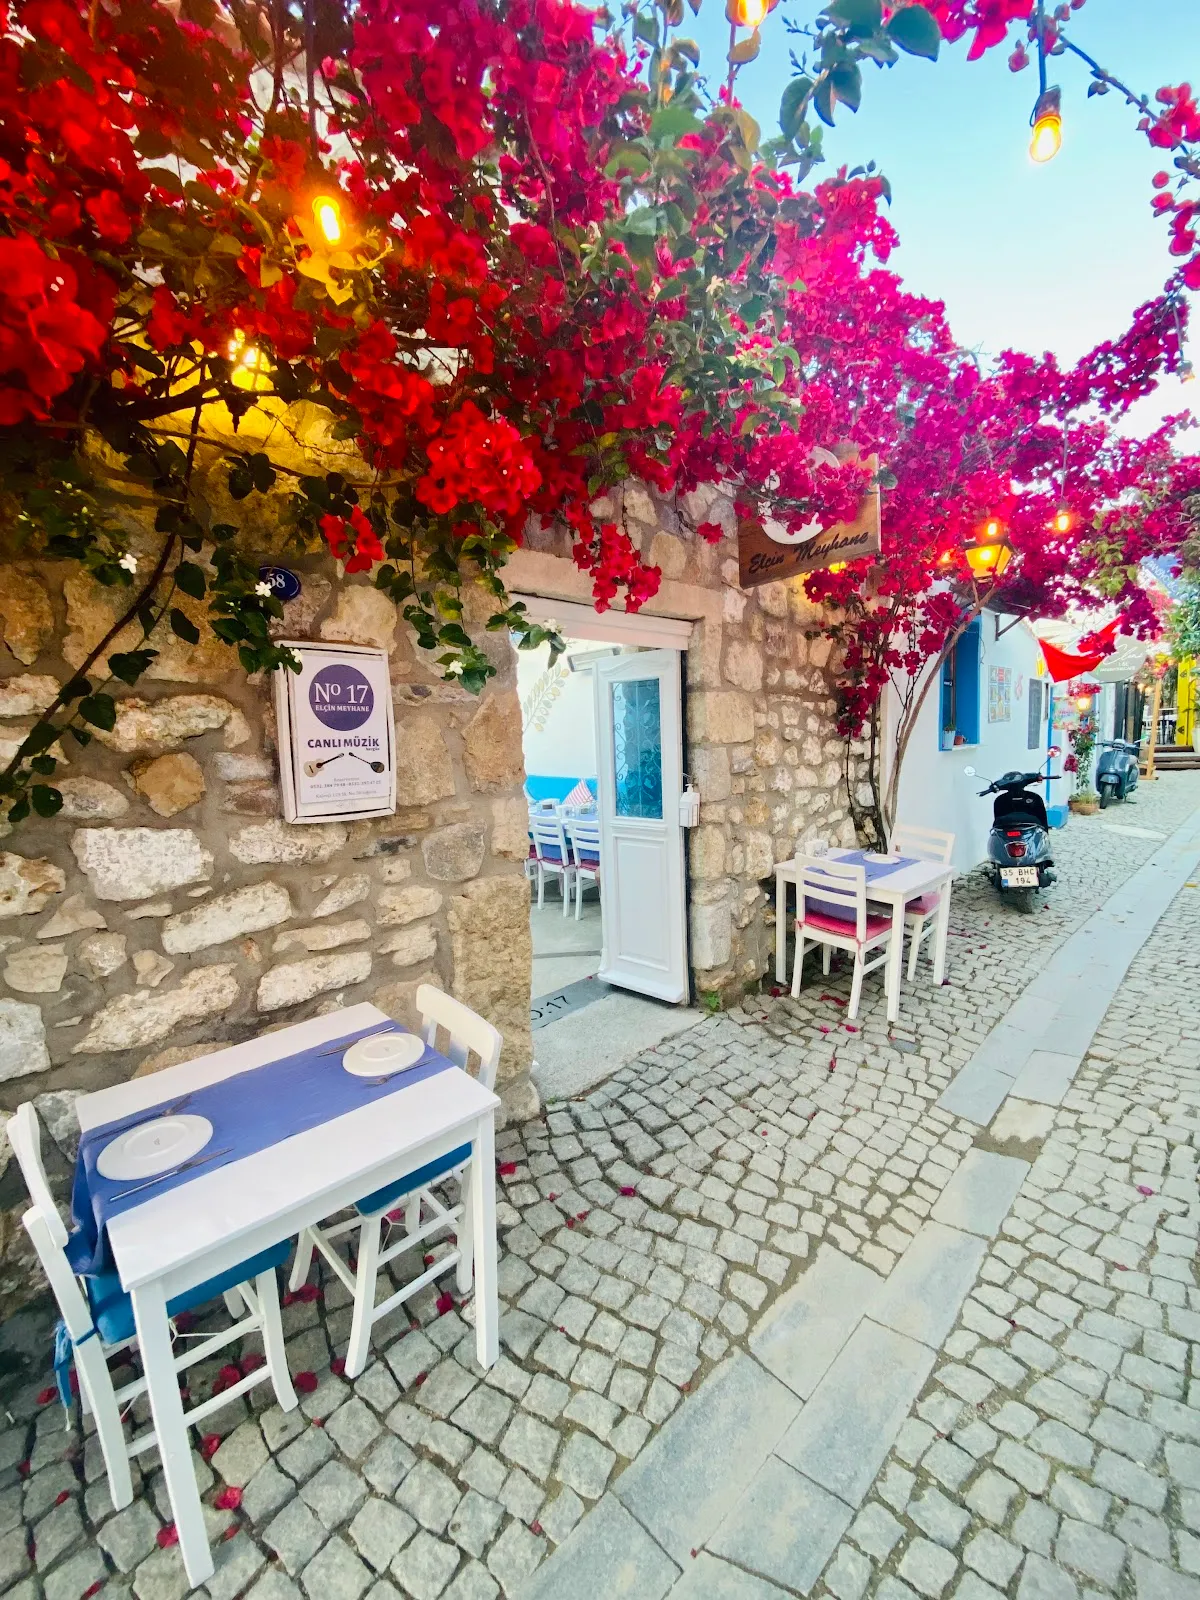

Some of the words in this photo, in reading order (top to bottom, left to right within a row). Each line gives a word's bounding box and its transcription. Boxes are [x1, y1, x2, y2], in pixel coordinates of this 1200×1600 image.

[793, 531, 869, 562] Meyhane
[267, 573, 286, 589] 58
[346, 684, 369, 704] 17
[307, 738, 342, 748] CANLI
[343, 735, 380, 748] MÜZİK
[1002, 869, 1014, 877] 35
[1015, 877, 1031, 885] 194
